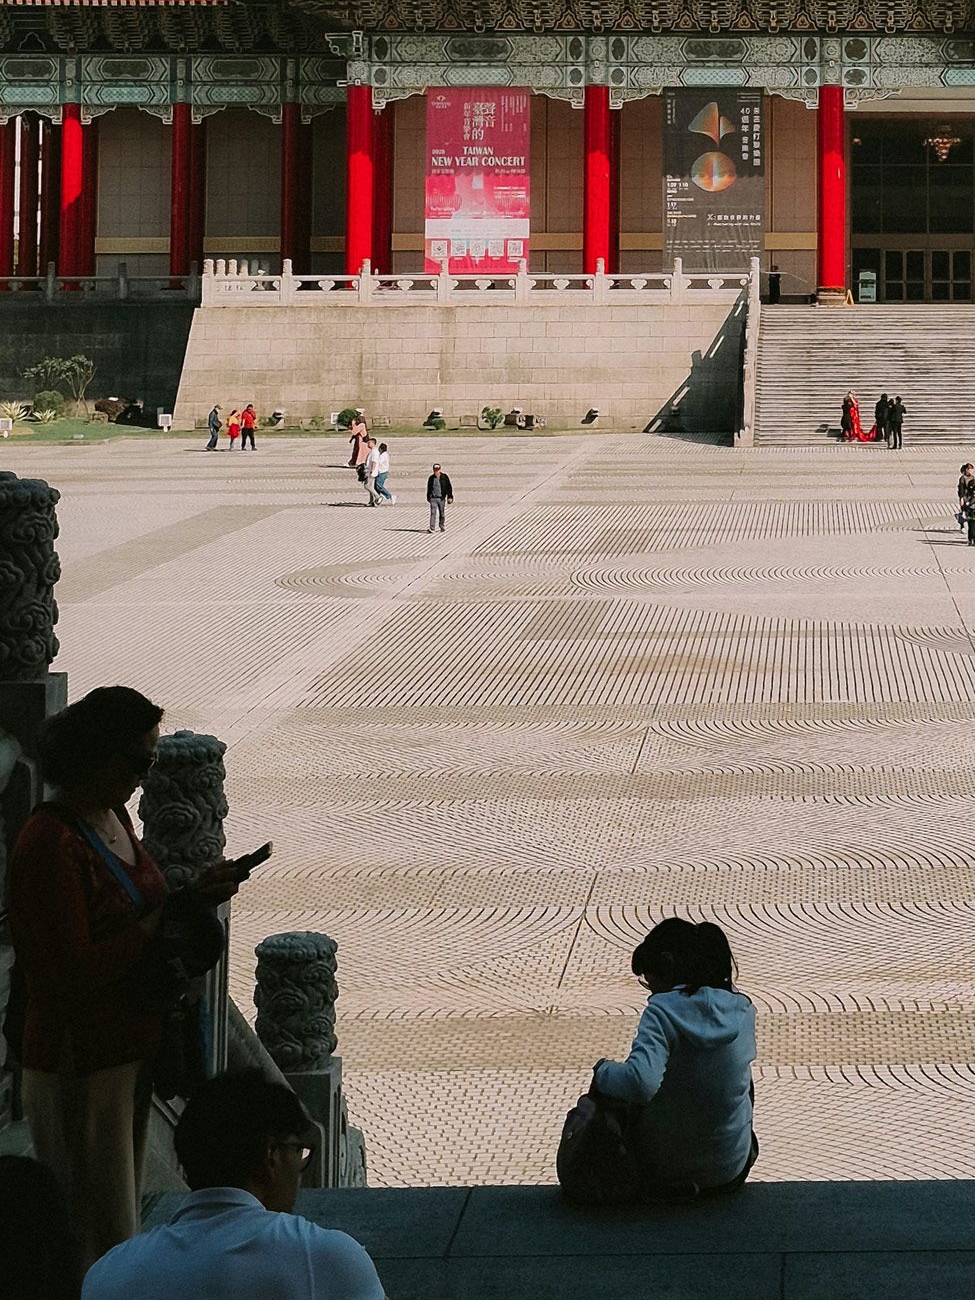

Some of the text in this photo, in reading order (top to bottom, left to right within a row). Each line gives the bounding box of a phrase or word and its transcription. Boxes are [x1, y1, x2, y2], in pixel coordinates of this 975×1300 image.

[462, 146, 494, 155] TAIWAN
[431, 156, 525, 167] NEW YEAR CONCERT
